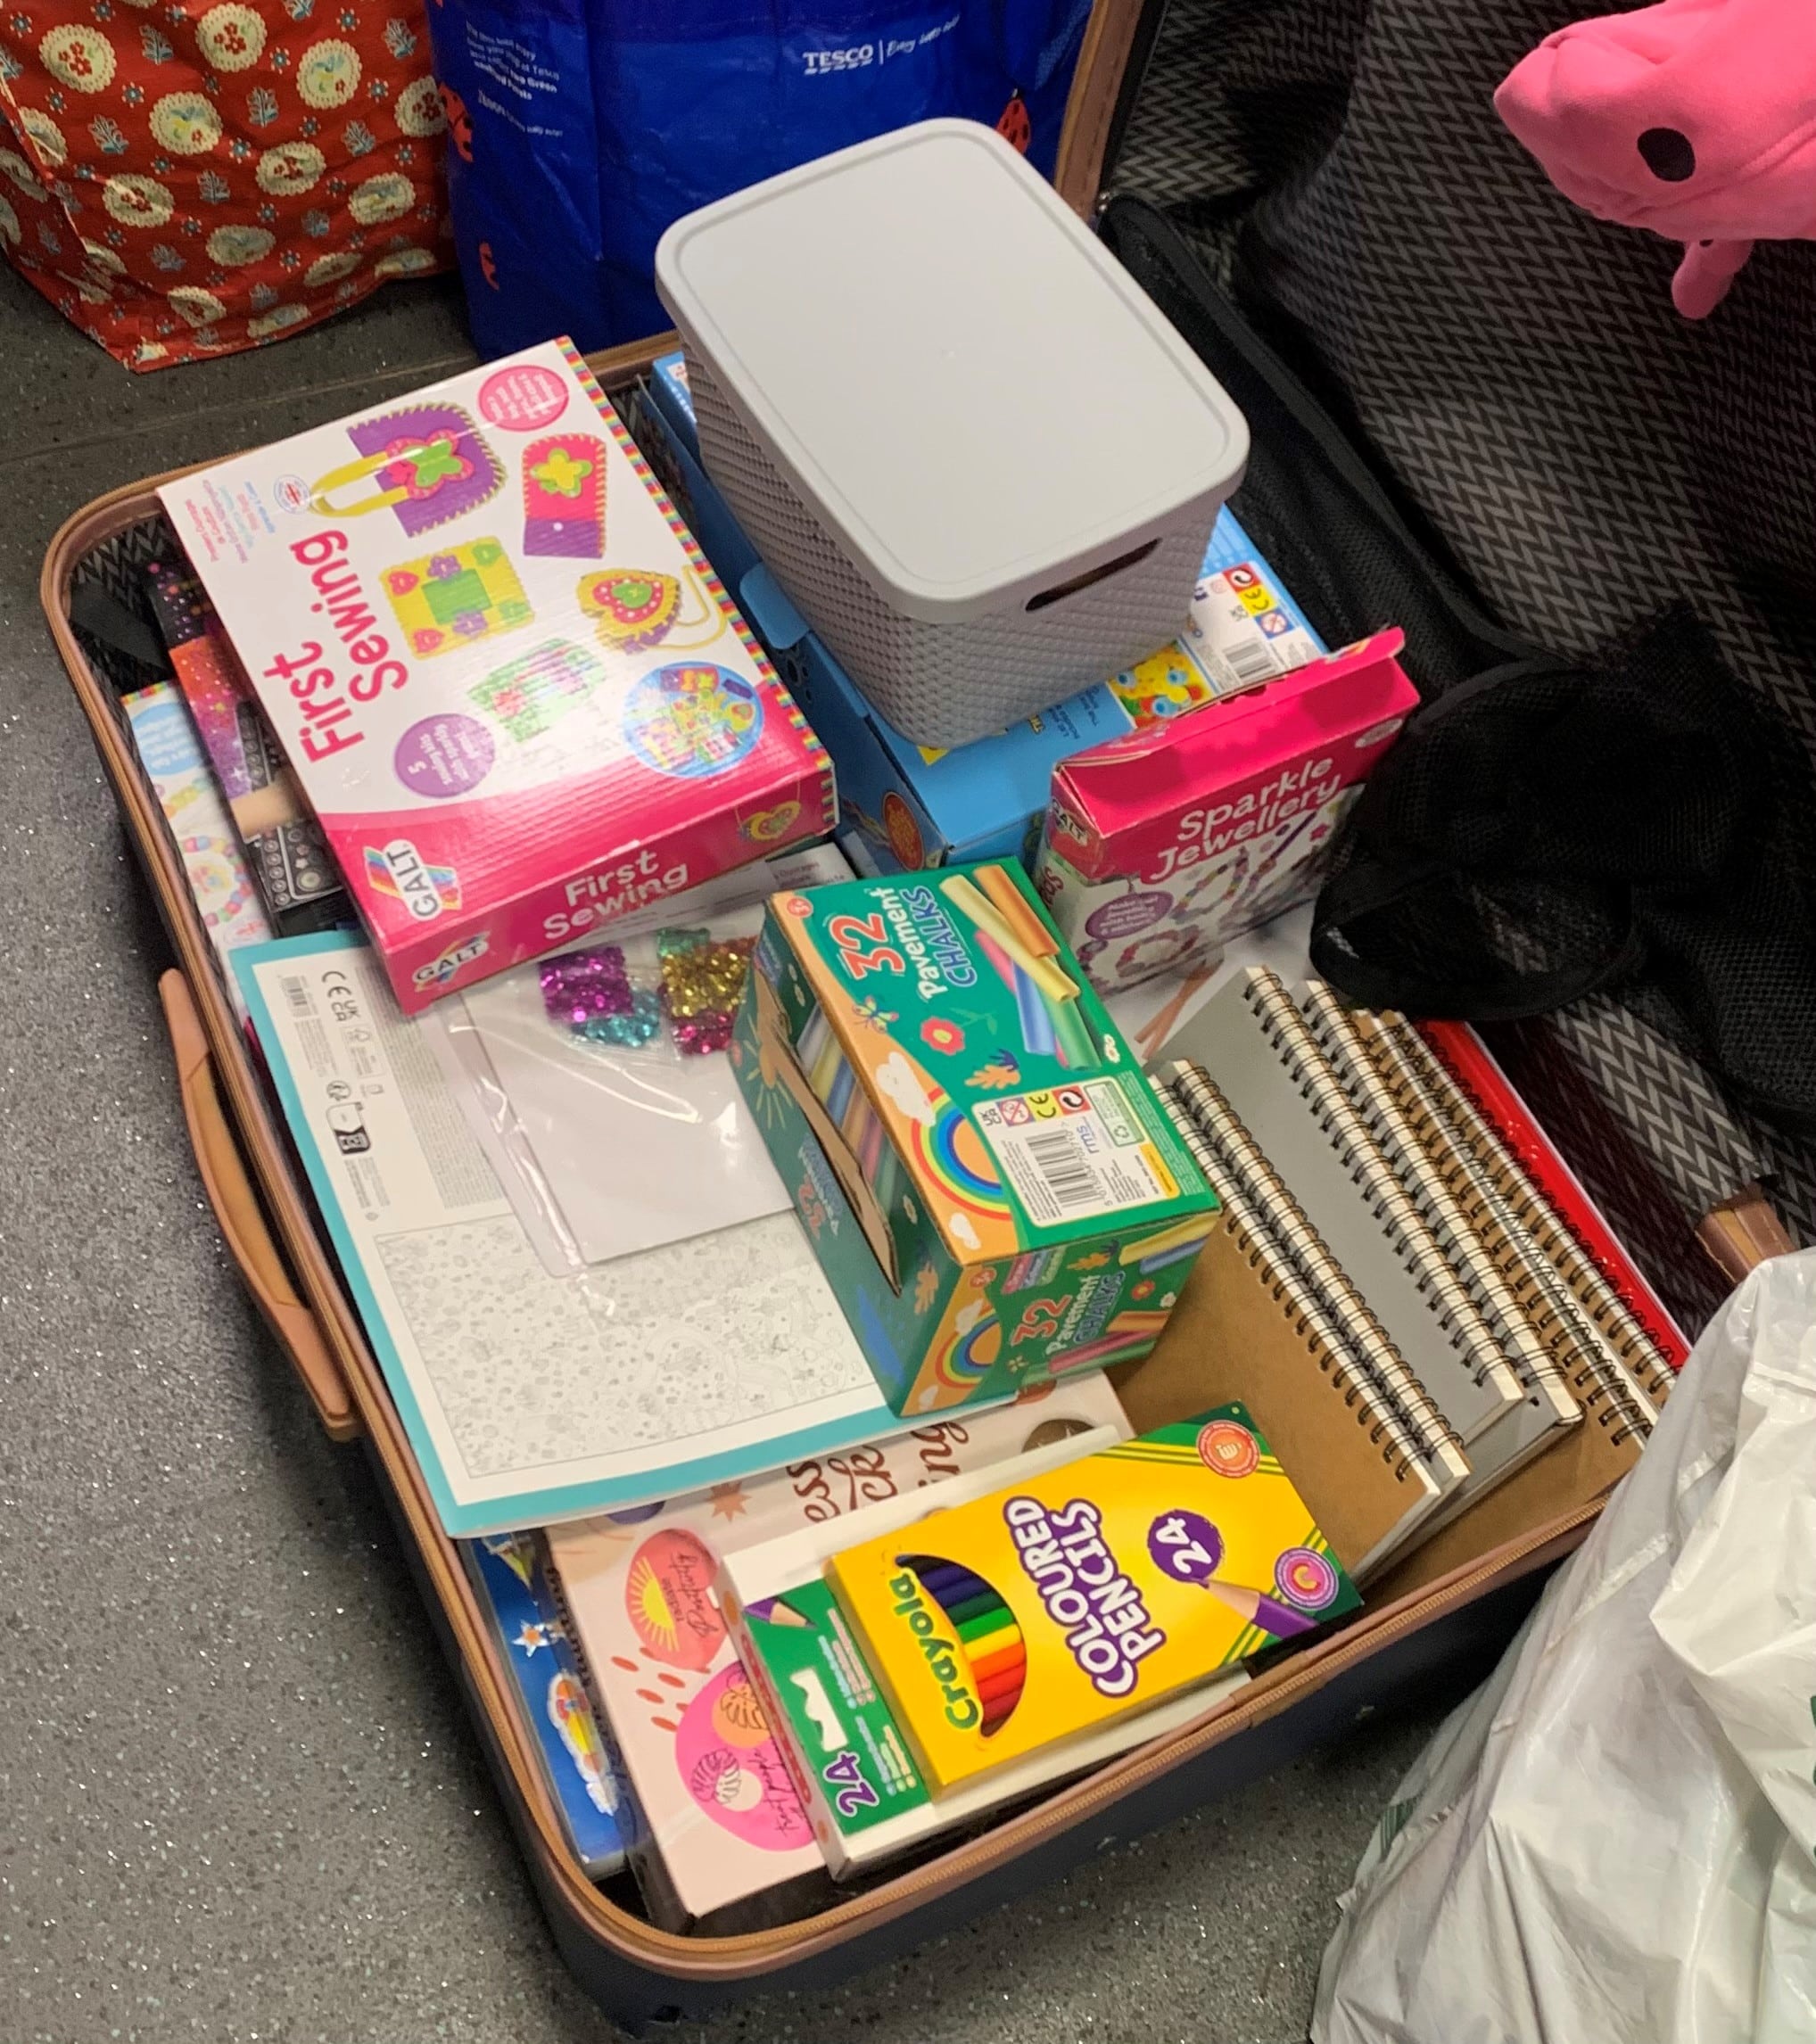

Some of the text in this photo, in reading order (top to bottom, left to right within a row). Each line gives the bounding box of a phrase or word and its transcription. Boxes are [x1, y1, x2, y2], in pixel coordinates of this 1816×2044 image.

[803, 45, 873, 73] TESCO
[290, 530, 408, 703] Sewing
[264, 640, 365, 762] First
[407, 759, 427, 774] 5
[1177, 758, 1333, 842] Sparkle
[1150, 774, 1341, 880] Jewellery
[386, 848, 442, 919] GALT
[543, 863, 689, 939] Sewing
[565, 850, 660, 908] First
[415, 943, 482, 983] GALT
[830, 914, 905, 981] 32
[865, 886, 946, 1001] Pavement
[912, 886, 978, 989] CHALKS
[978, 1110, 994, 1125] UK
[1074, 1125, 1099, 1153] rms
[1011, 1295, 1070, 1348] 32
[1045, 1274, 1102, 1355] Pavement
[1055, 1502, 1162, 1663] PENCILS
[1156, 1518, 1212, 1575] 24
[1008, 1500, 1135, 1694] COLOURED
[889, 1573, 981, 1732] Crayola
[824, 1751, 879, 1817] 24
